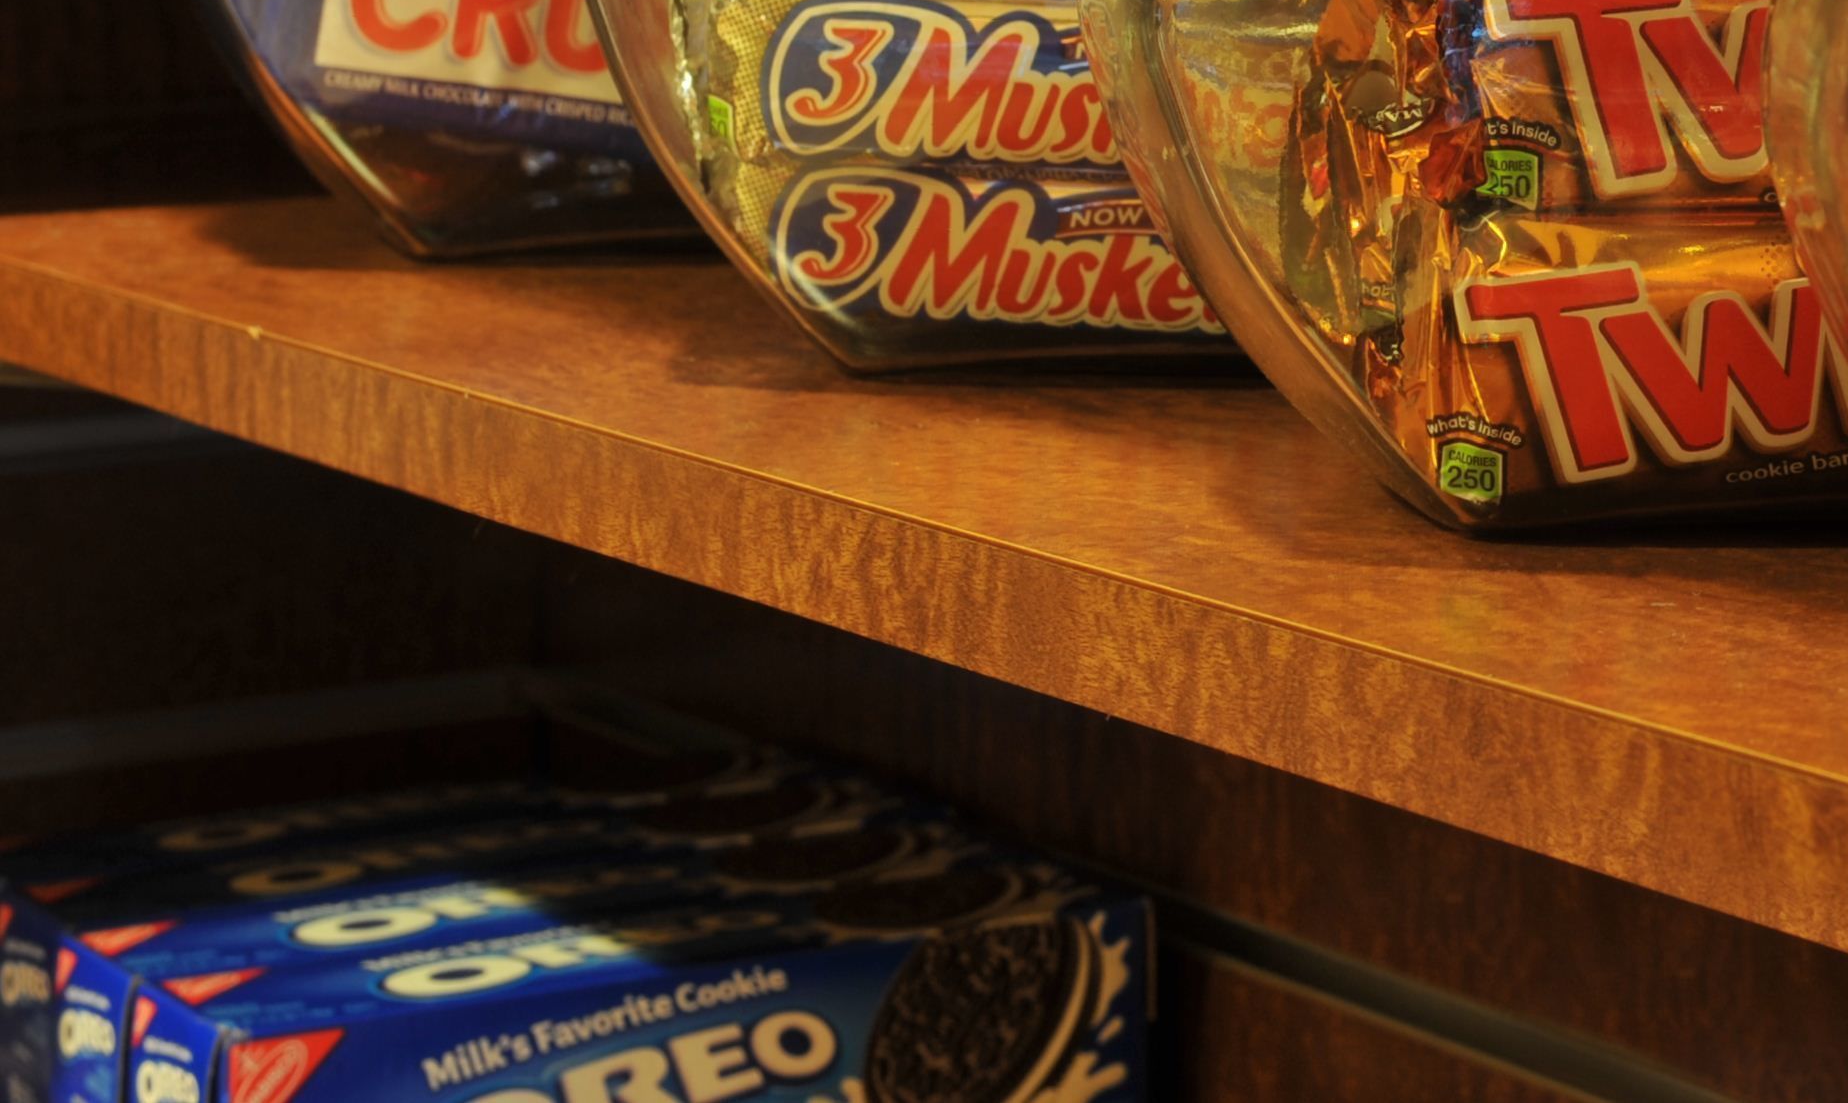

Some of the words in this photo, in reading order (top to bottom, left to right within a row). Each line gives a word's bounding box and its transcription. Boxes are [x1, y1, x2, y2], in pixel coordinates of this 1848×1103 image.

[325, 70, 384, 91] CREAMY
[386, 78, 418, 96] MILK
[786, 18, 894, 125] 3
[1511, 121, 1557, 148] inside
[1488, 172, 1532, 199] 250
[1068, 206, 1145, 229] NOW
[792, 183, 896, 284] 3
[1426, 415, 1476, 435] what's
[1477, 418, 1523, 447] inside
[1447, 449, 1497, 467] CALORIES
[1446, 464, 1496, 492] 250
[1723, 459, 1805, 485] cookie
[420, 1033, 534, 1092] Milk's
[529, 993, 676, 1055] Favorite
[675, 965, 789, 1012] Cookie
[464, 1010, 838, 1103] REO
